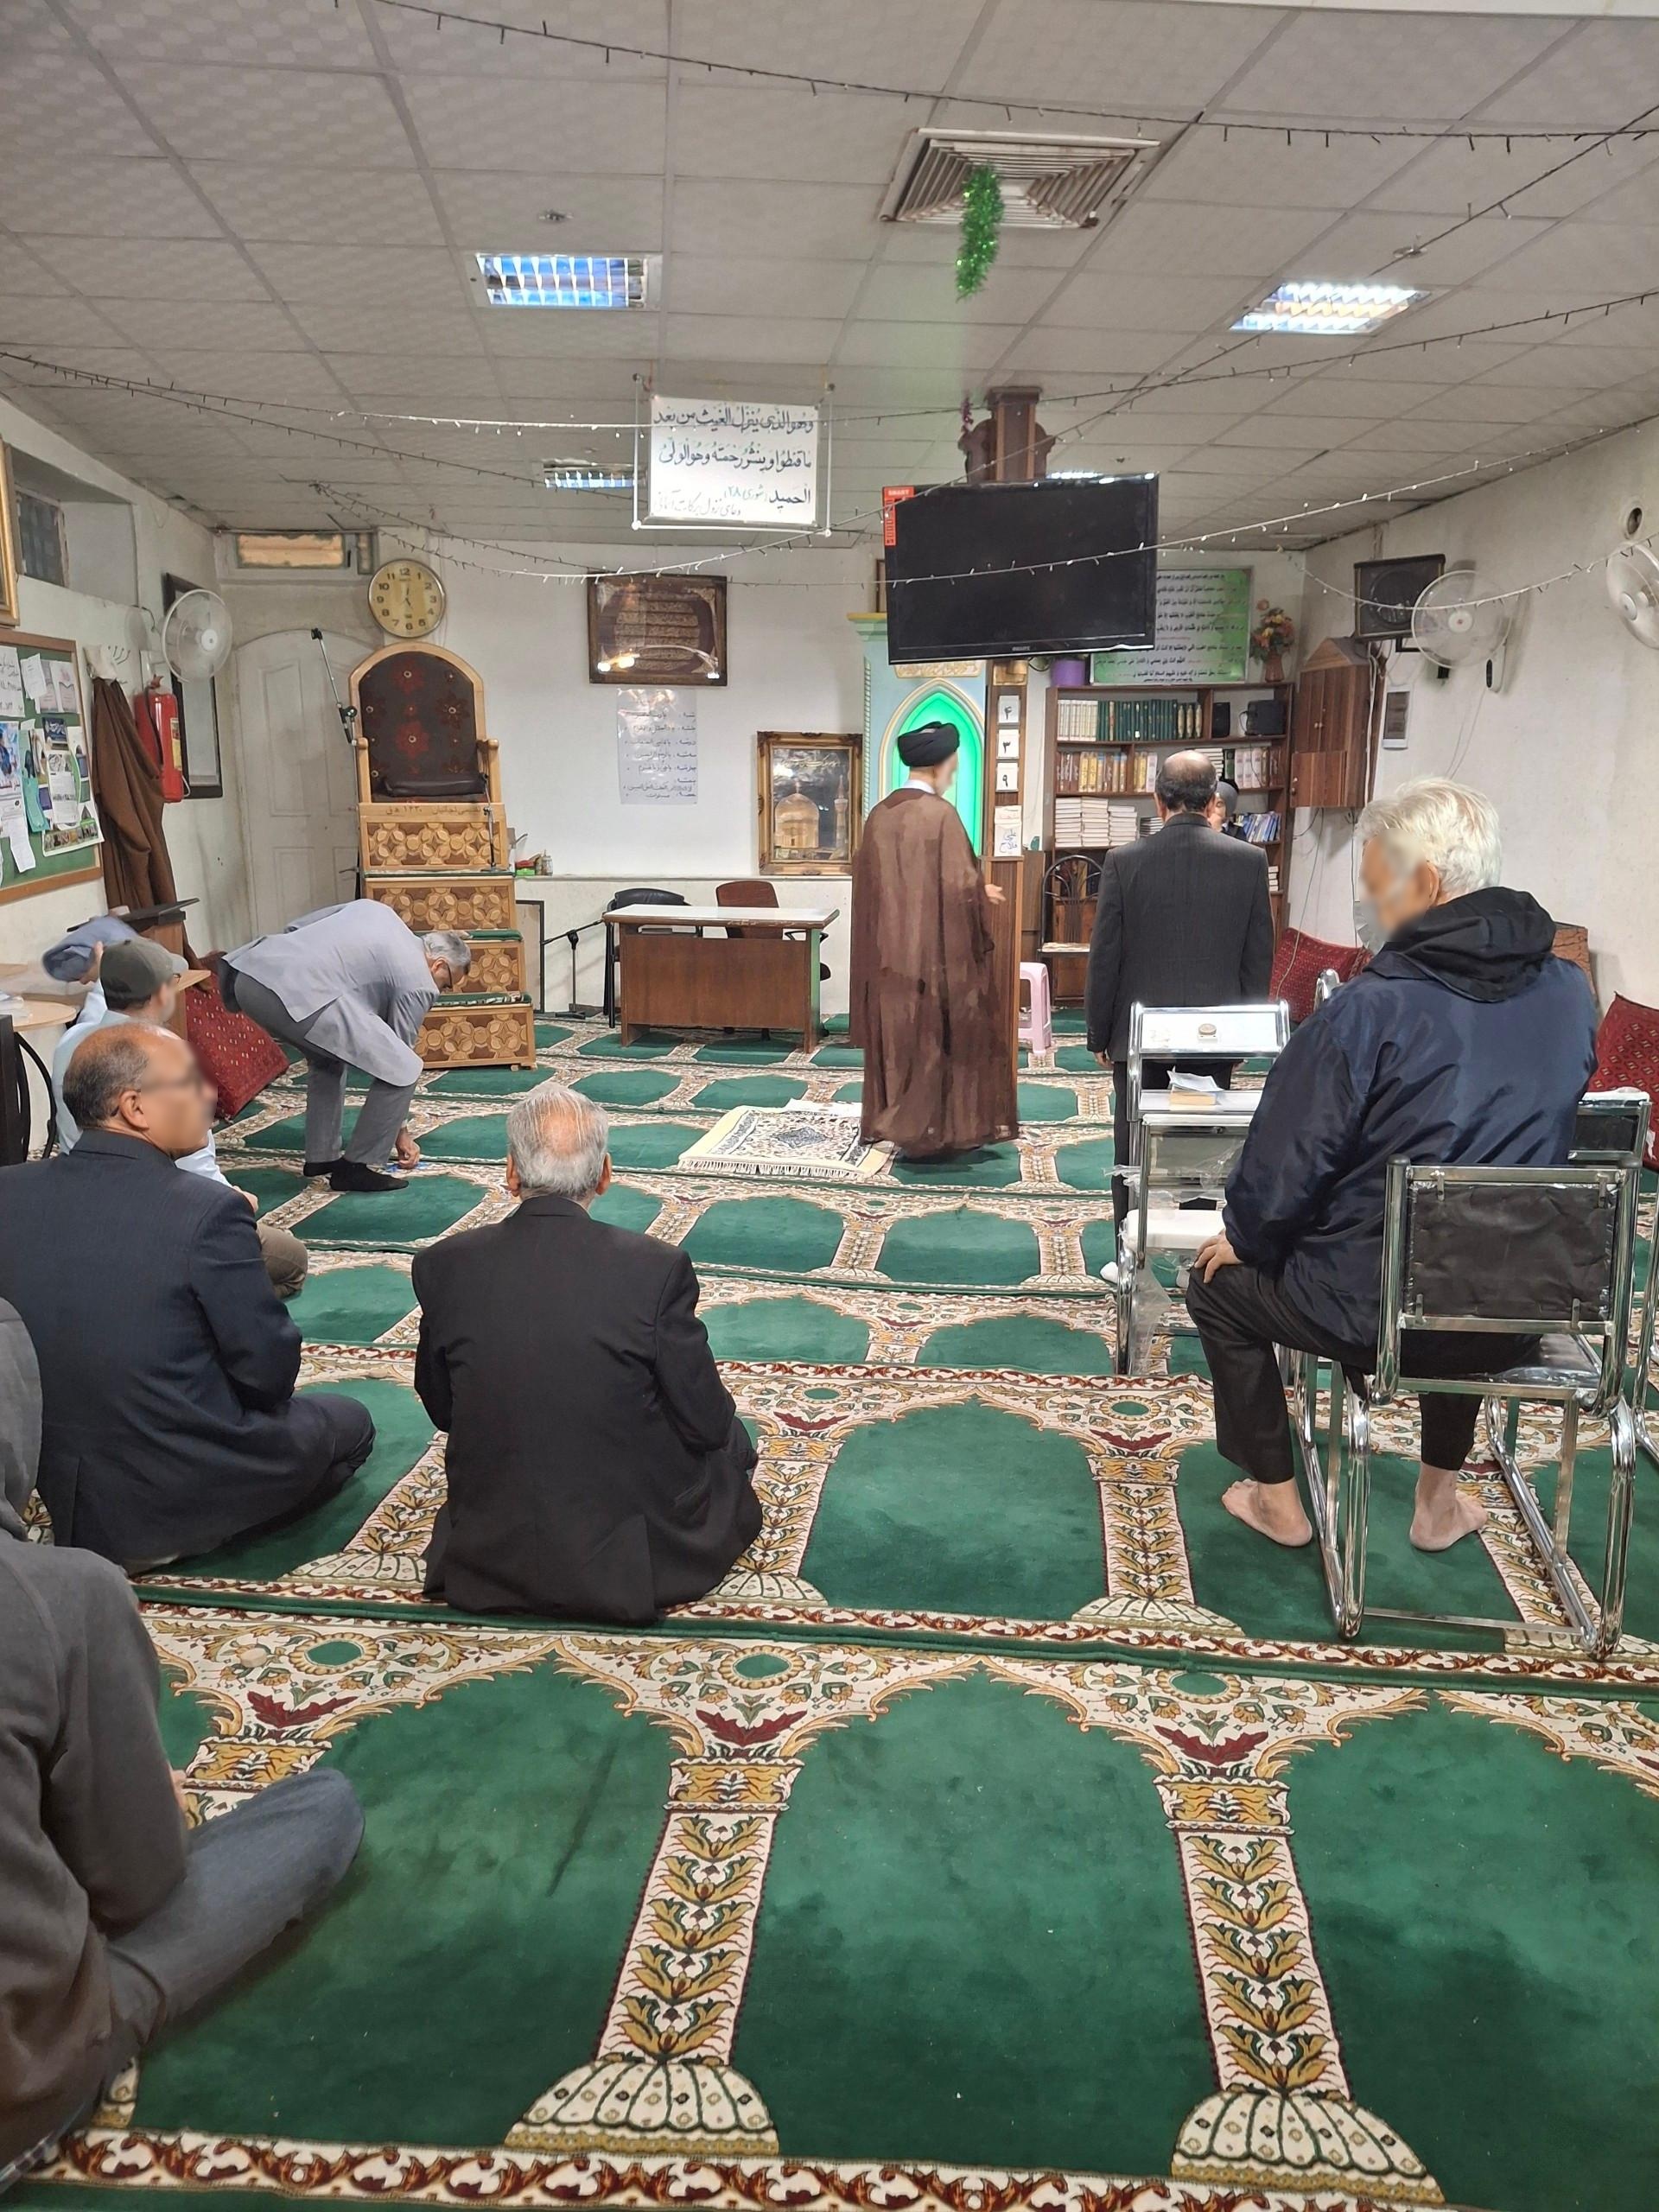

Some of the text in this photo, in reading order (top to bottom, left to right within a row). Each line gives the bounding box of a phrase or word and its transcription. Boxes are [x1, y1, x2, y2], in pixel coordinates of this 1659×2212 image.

[768, 483, 811, 508] الحمید
[1004, 706, 1012, 720] ۴
[1002, 741, 1011, 753] ۳
[1002, 774, 1008, 787] ۹
